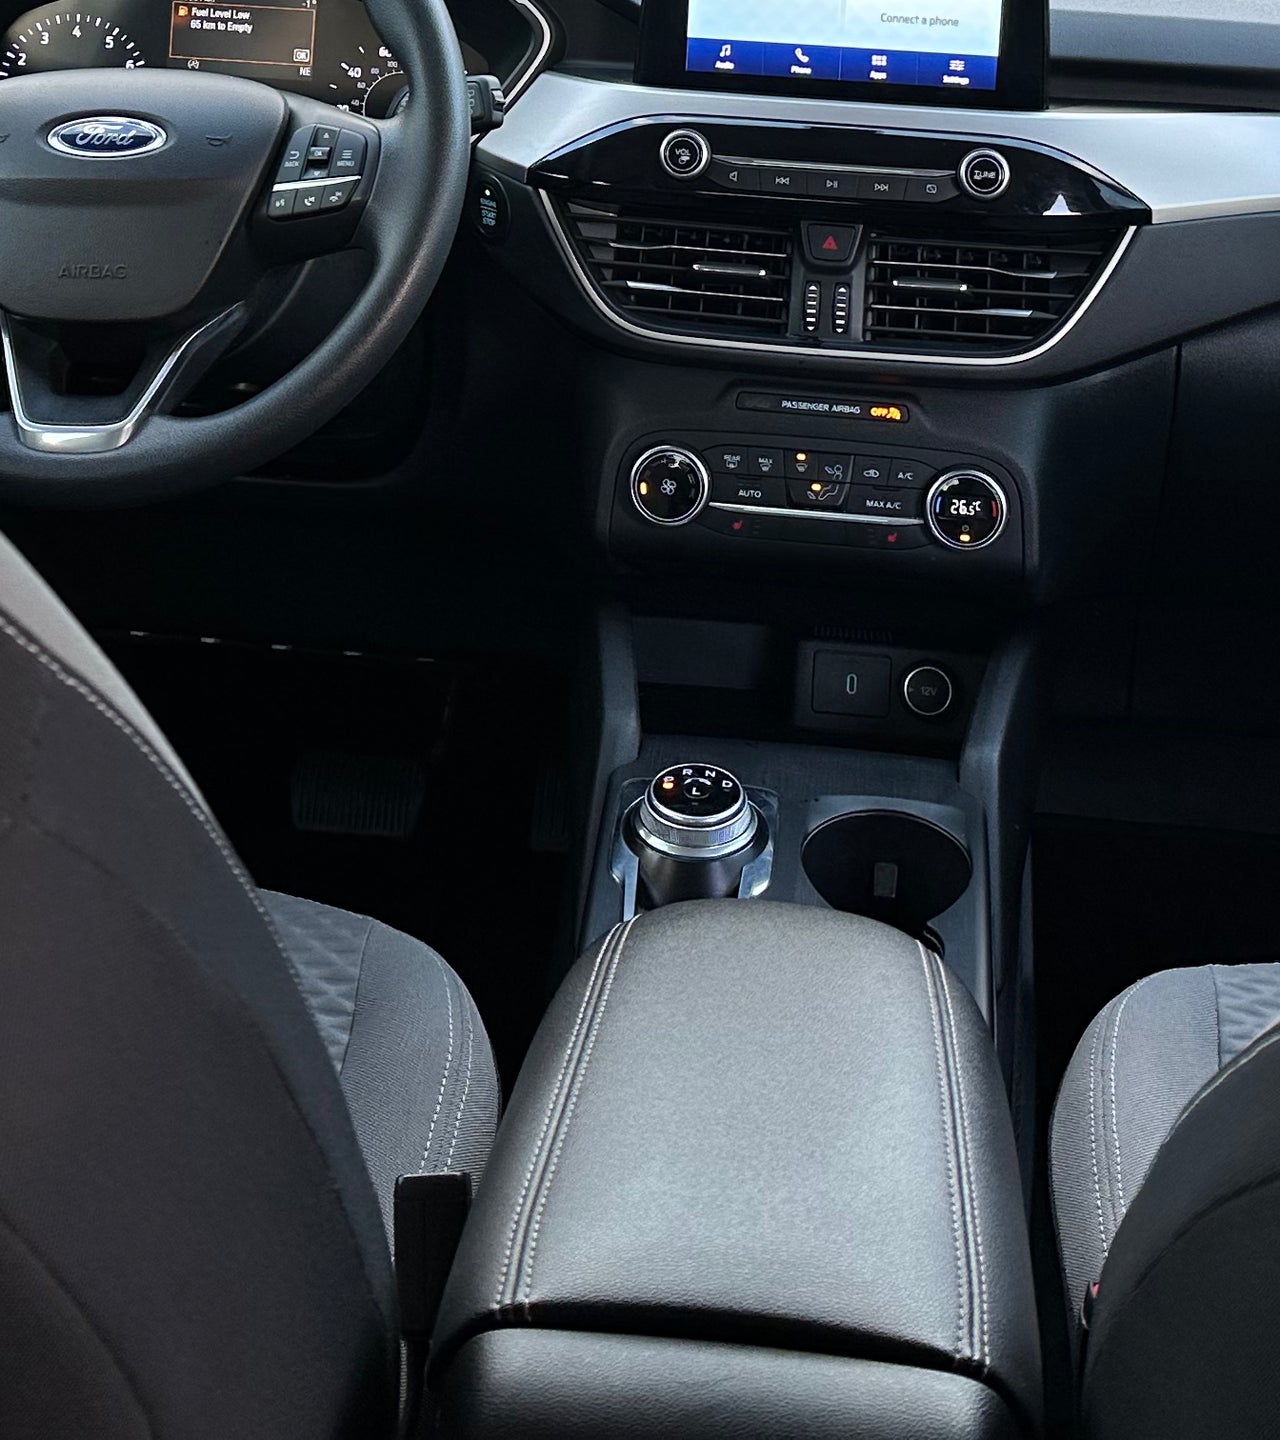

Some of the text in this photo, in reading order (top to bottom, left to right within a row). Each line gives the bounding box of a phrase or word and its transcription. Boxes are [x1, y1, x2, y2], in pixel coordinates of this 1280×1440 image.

[191, 7, 251, 20] Fuel Level Low
[880, 12, 960, 27] Connect a phone
[72, 25, 82, 37] 4
[190, 19, 254, 34] 65 km to Empty
[40, 32, 50, 45] 3
[105, 35, 114, 49] 5
[18, 53, 27, 66] 2
[299, 67, 312, 76] NE
[347, 67, 362, 78] 40
[75, 124, 136, 146] Ford
[675, 148, 691, 156] VOL
[58, 264, 128, 279] AIRBAG
[781, 400, 830, 412] PASSENGER
[831, 405, 861, 414] AIRBAG
[897, 471, 914, 481] A/C
[738, 489, 762, 498] AUTO
[865, 499, 902, 510] MAX A/C
[920, 686, 937, 697] 12V
[682, 768, 693, 776] R
[705, 770, 716, 778] N
[722, 780, 733, 788] D
[692, 787, 701, 795] L
